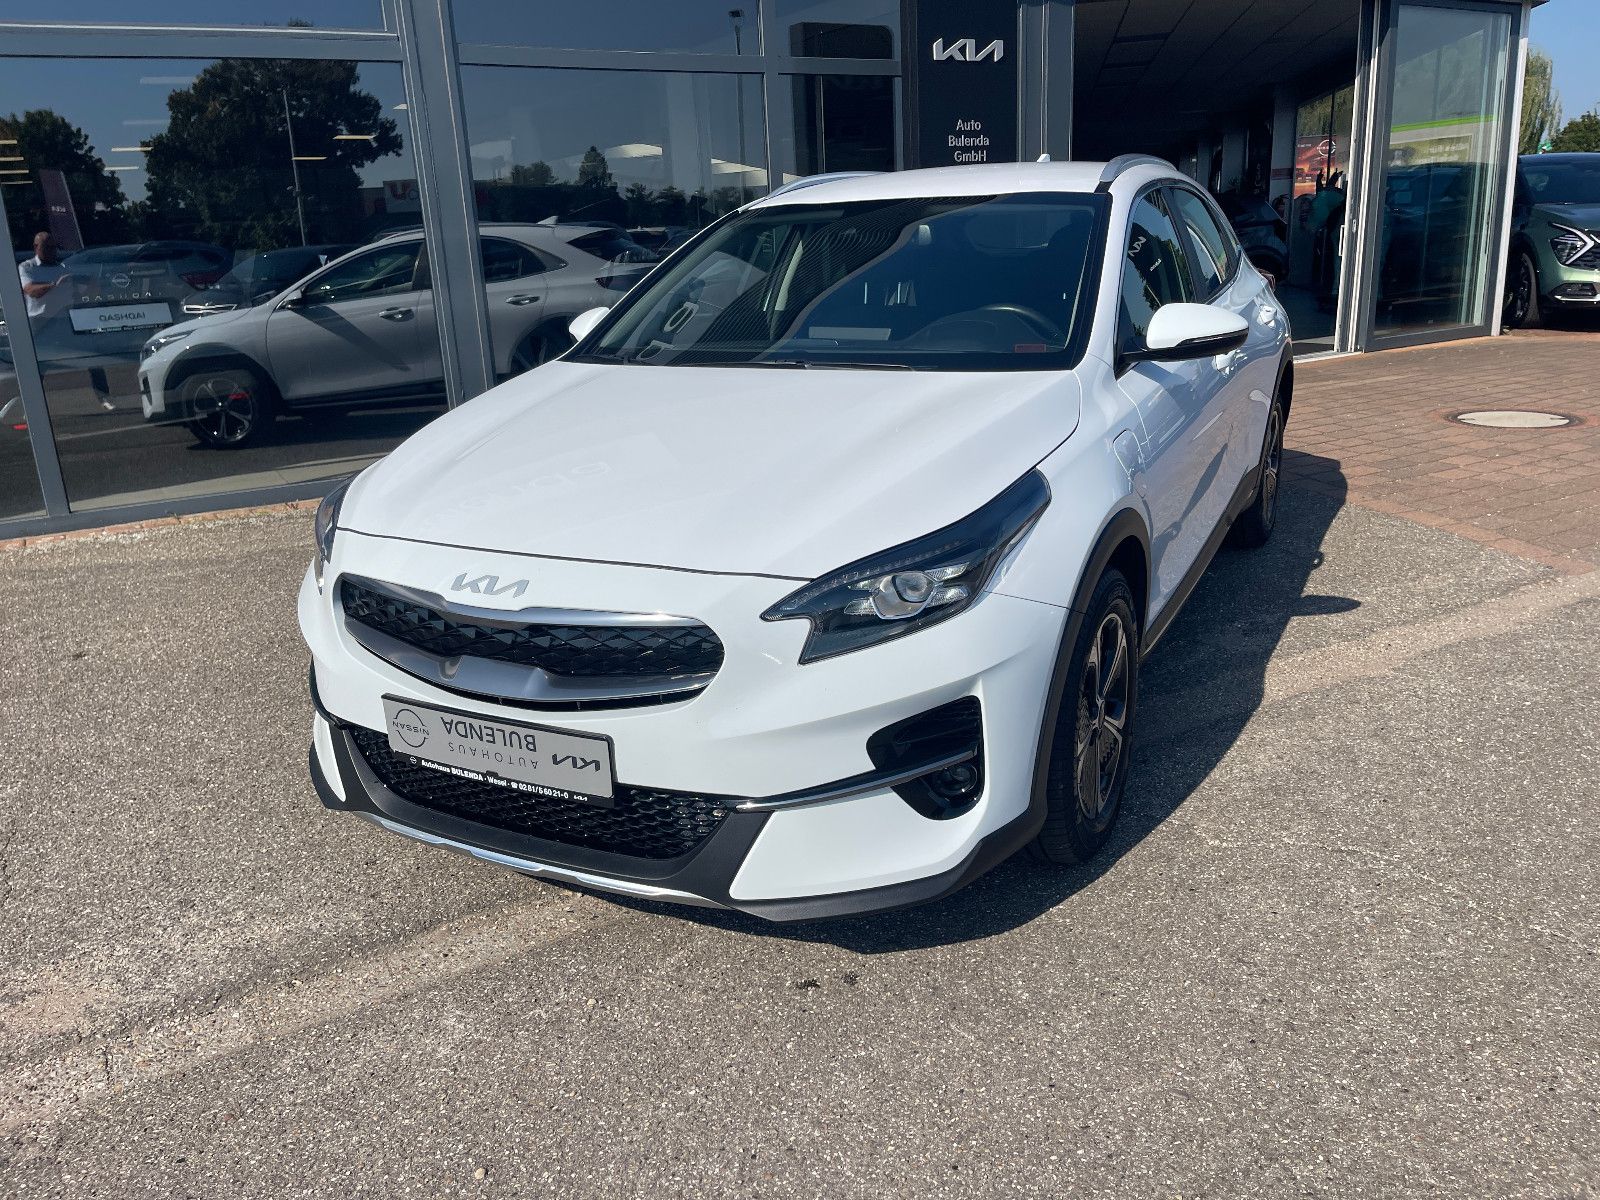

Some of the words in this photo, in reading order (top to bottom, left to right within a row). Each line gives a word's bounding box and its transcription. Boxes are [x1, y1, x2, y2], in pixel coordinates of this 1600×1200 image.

[933, 37, 1004, 63] KIA
[956, 119, 981, 131] Auto
[948, 134, 990, 147] Bulenda
[954, 150, 987, 162] GmbH
[98, 311, 146, 322] QASHQAI
[450, 572, 530, 599] KIA
[392, 720, 430, 735] NISSAN
[440, 716, 537, 752] BULENDA
[448, 742, 539, 769] AUTOHAUS
[551, 753, 601, 772] KIA
[421, 759, 450, 773] Autohaus
[451, 767, 484, 782] BULENDA
[486, 775, 507, 787] Wesel
